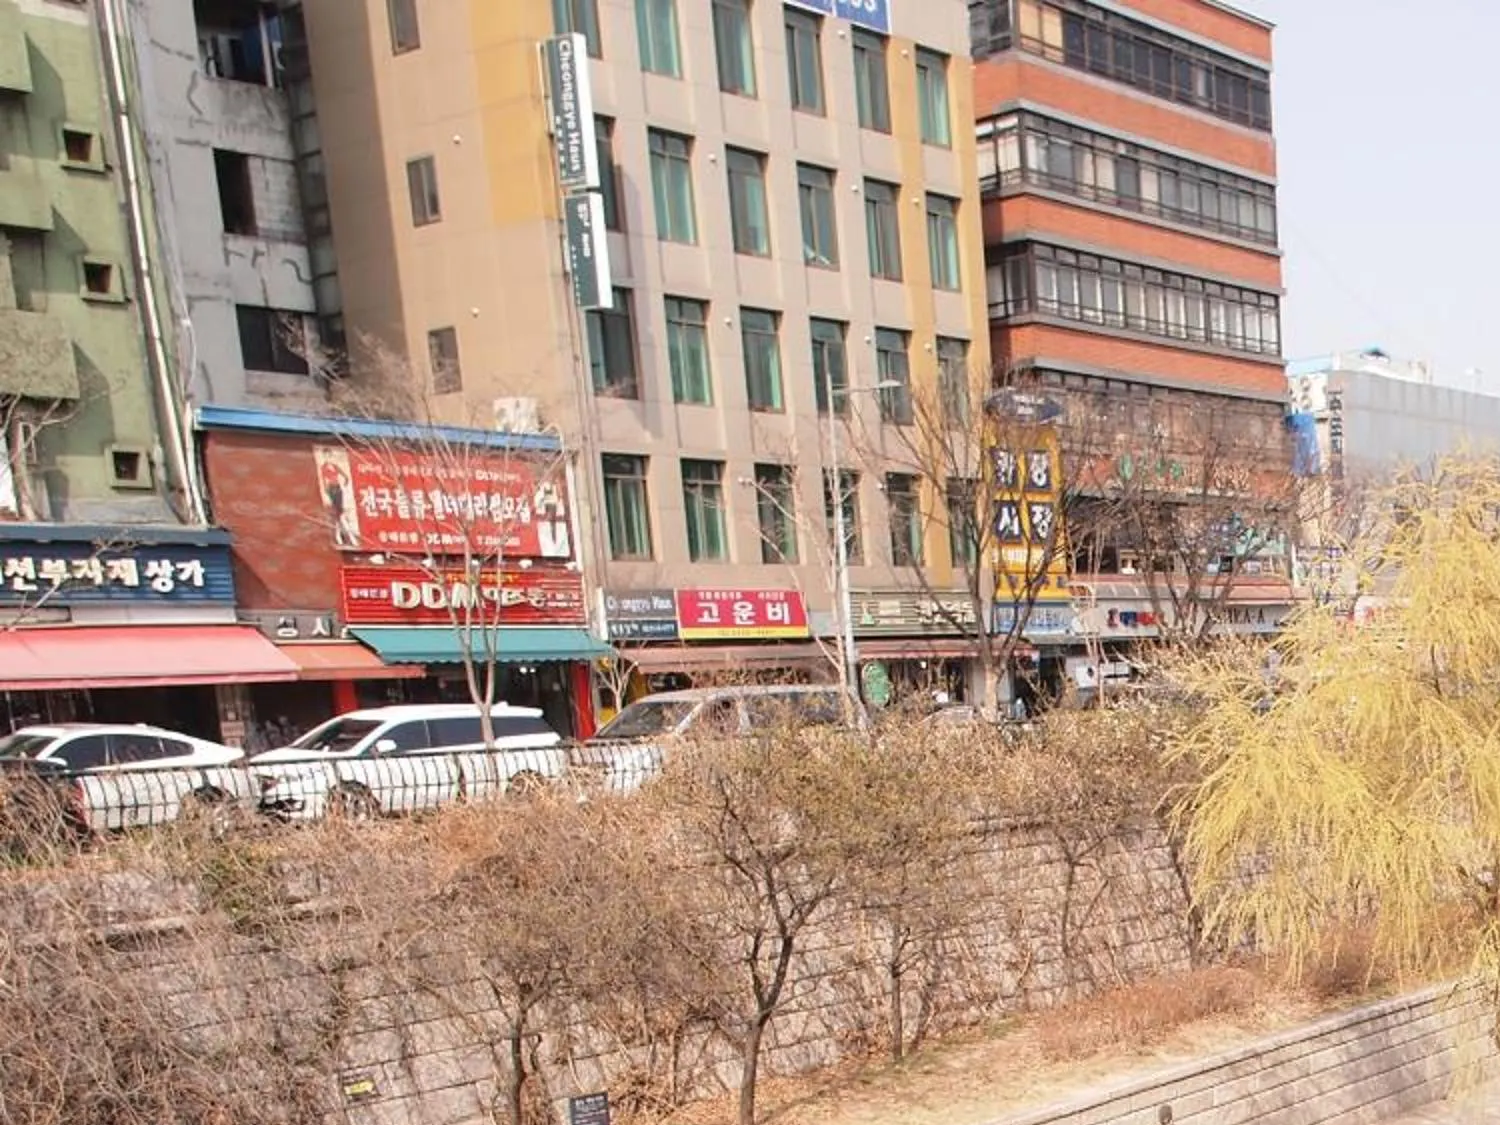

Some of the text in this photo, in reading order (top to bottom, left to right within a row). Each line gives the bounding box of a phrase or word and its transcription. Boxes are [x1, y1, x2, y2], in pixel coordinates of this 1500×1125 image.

[0, 557, 204, 592] 선부자재 상가
[696, 600, 790, 625] 고운비
